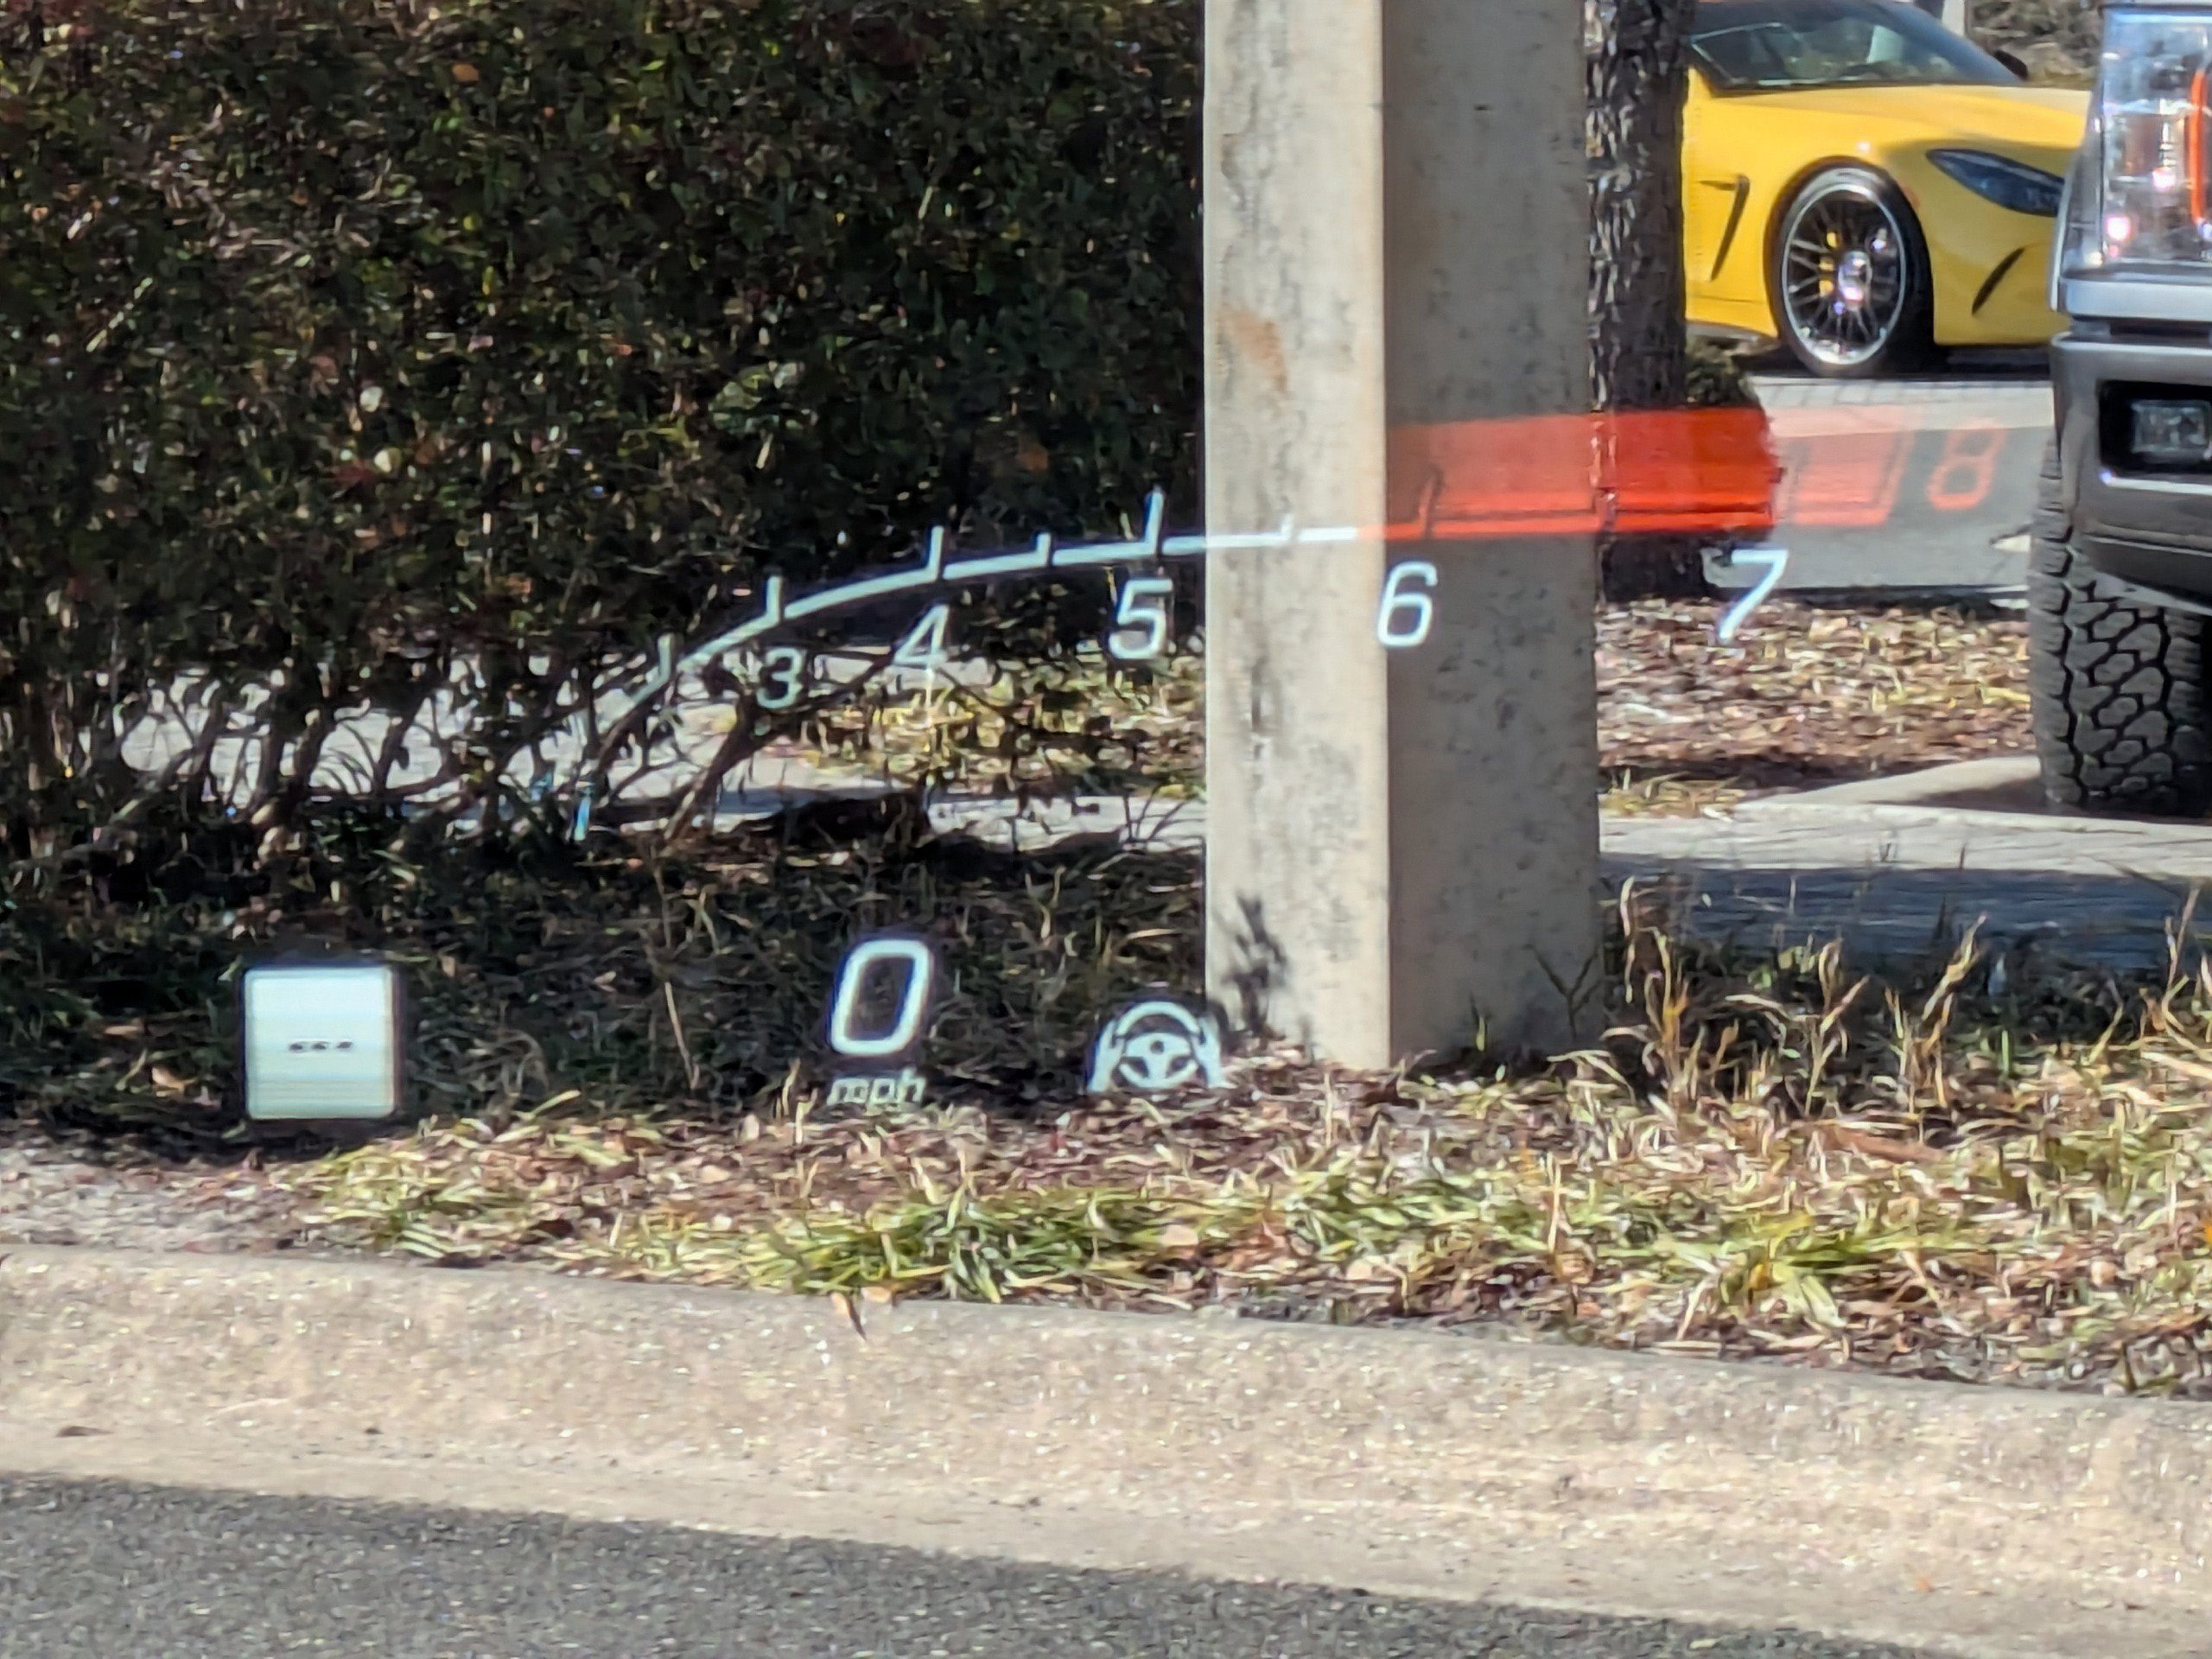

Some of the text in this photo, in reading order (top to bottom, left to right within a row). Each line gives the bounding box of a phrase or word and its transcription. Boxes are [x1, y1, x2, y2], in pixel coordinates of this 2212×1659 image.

[1928, 421, 2005, 511] 8
[1109, 578, 1173, 660] 5
[1376, 560, 1438, 647] 6
[1718, 549, 1789, 641] 7
[756, 647, 805, 709] 3
[894, 604, 949, 674] 4
[830, 939, 933, 1056] 0
[827, 1068, 926, 1109] mph
